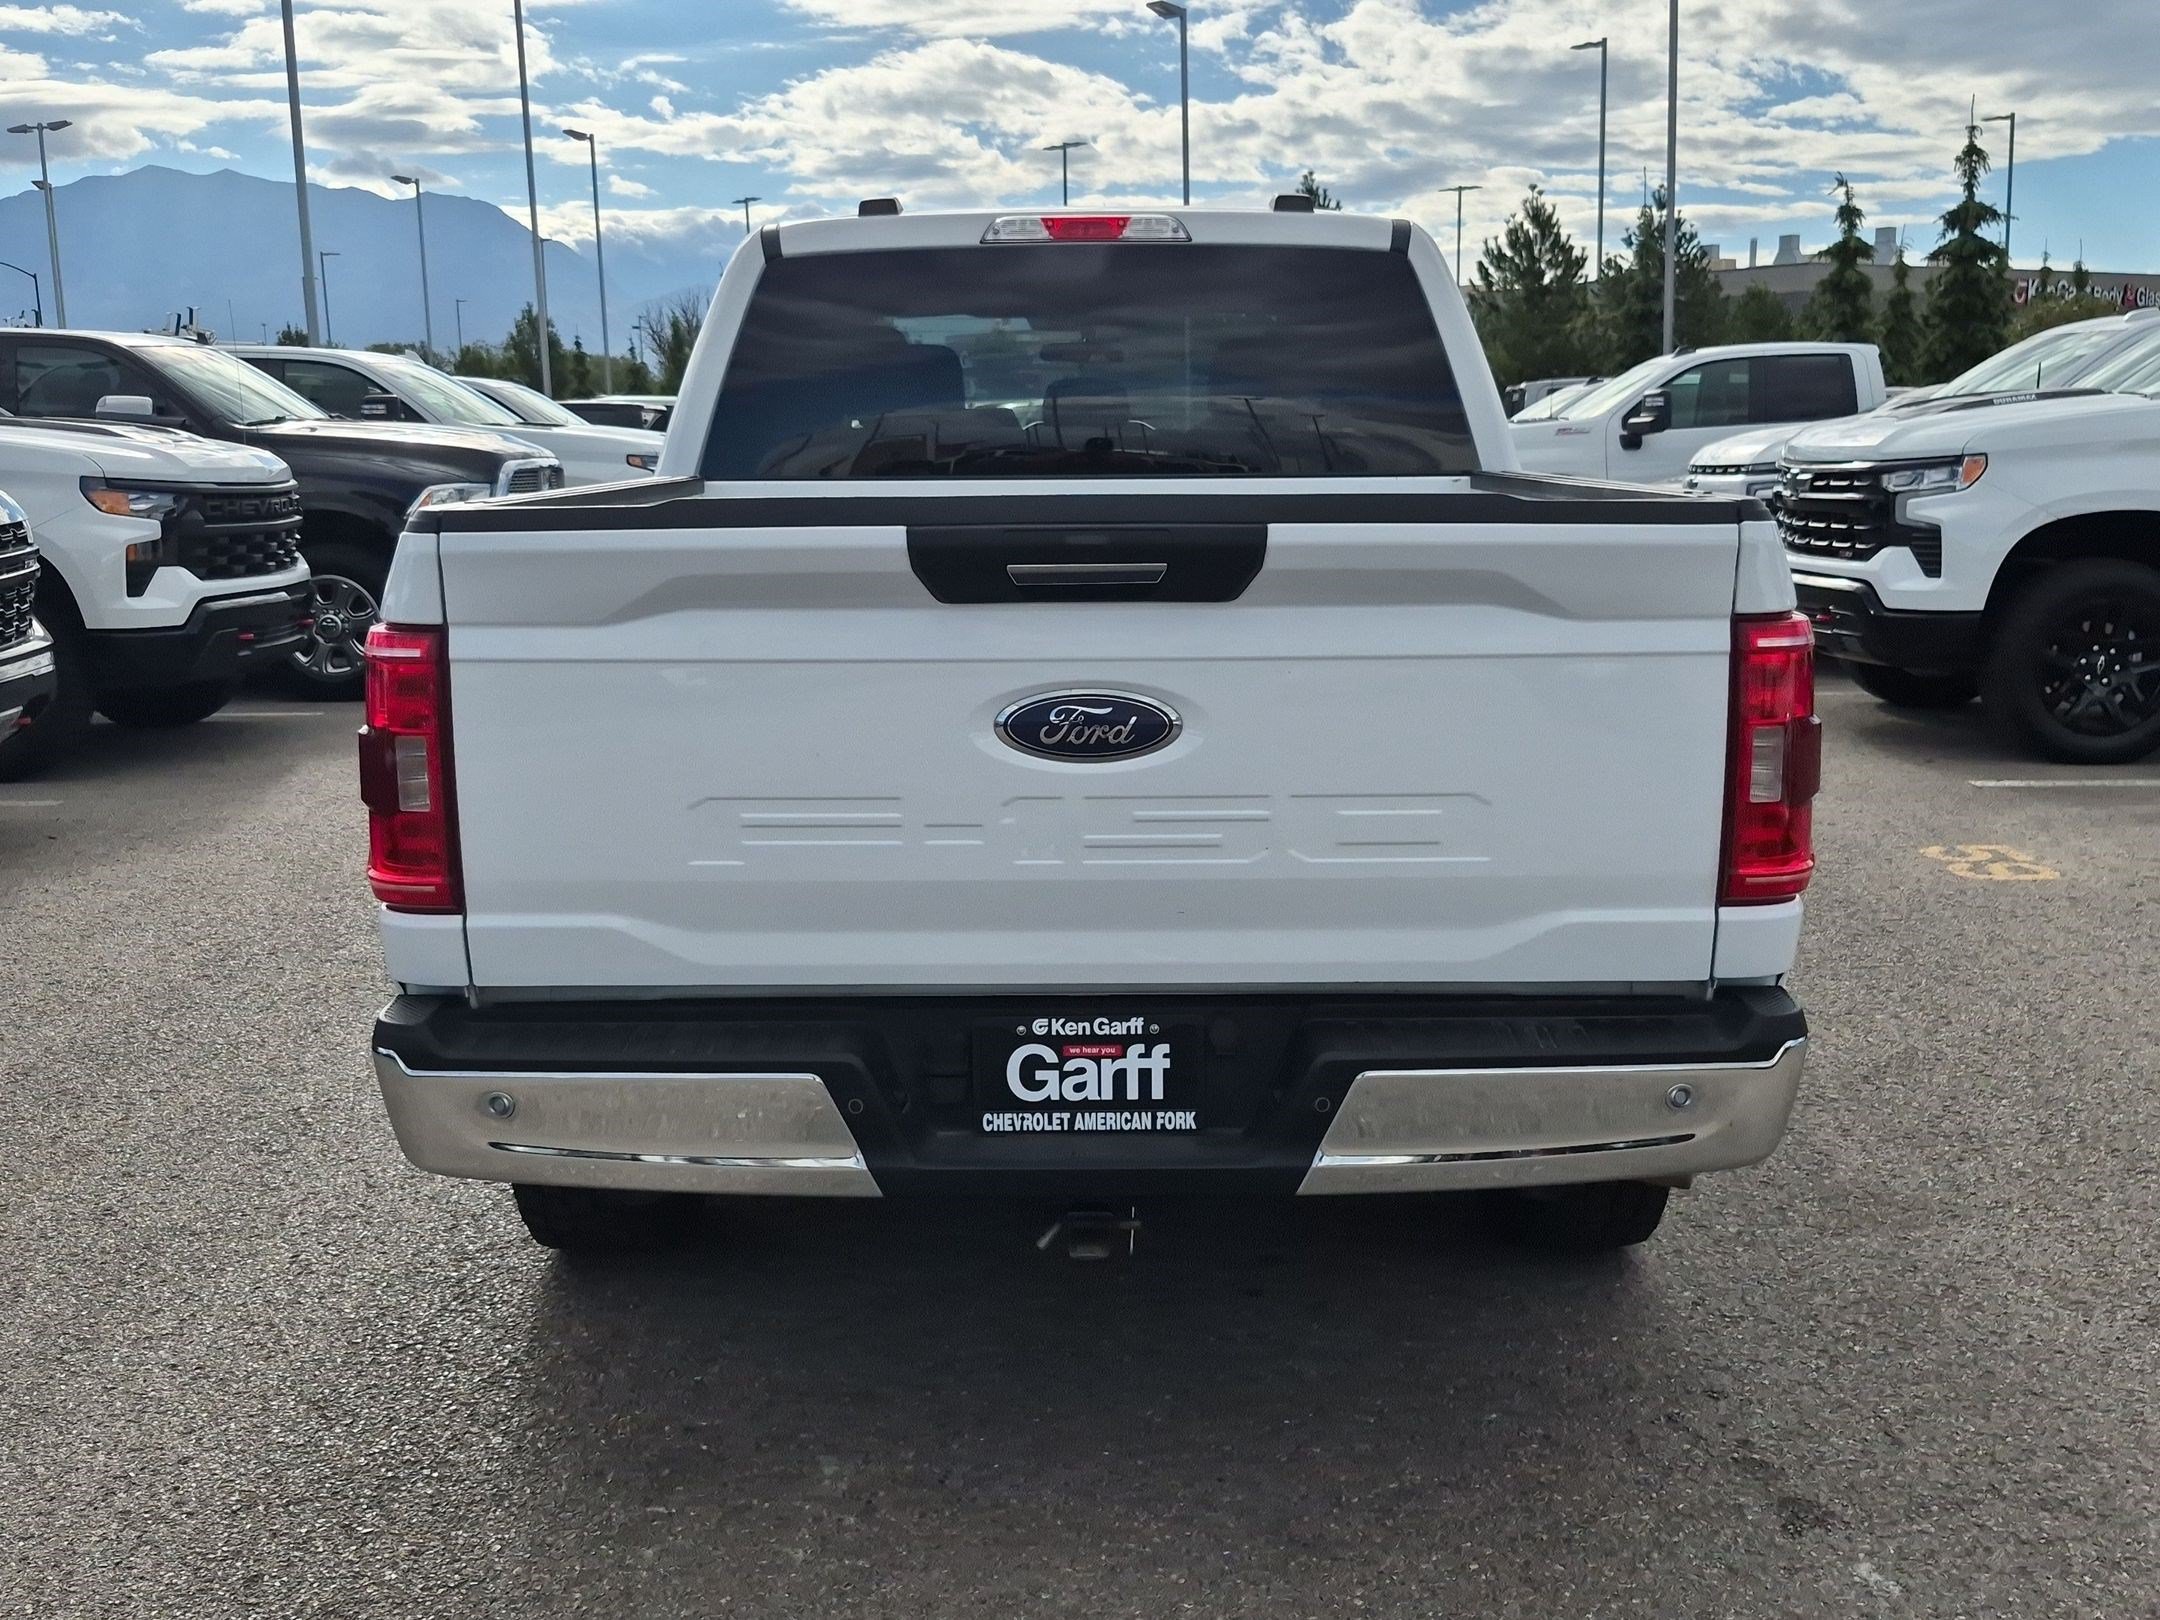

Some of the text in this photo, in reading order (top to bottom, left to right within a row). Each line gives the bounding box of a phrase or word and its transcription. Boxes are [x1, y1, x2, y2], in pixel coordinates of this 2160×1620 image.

[1039, 705, 1138, 745] Ford
[1051, 1017, 1144, 1036] Ken Garff
[1082, 1046, 1099, 1054] hear
[1101, 1047, 1116, 1056] you
[1006, 1043, 1171, 1102] Garff
[982, 1111, 1197, 1132] CHEVROLET AMERICAN FORK
